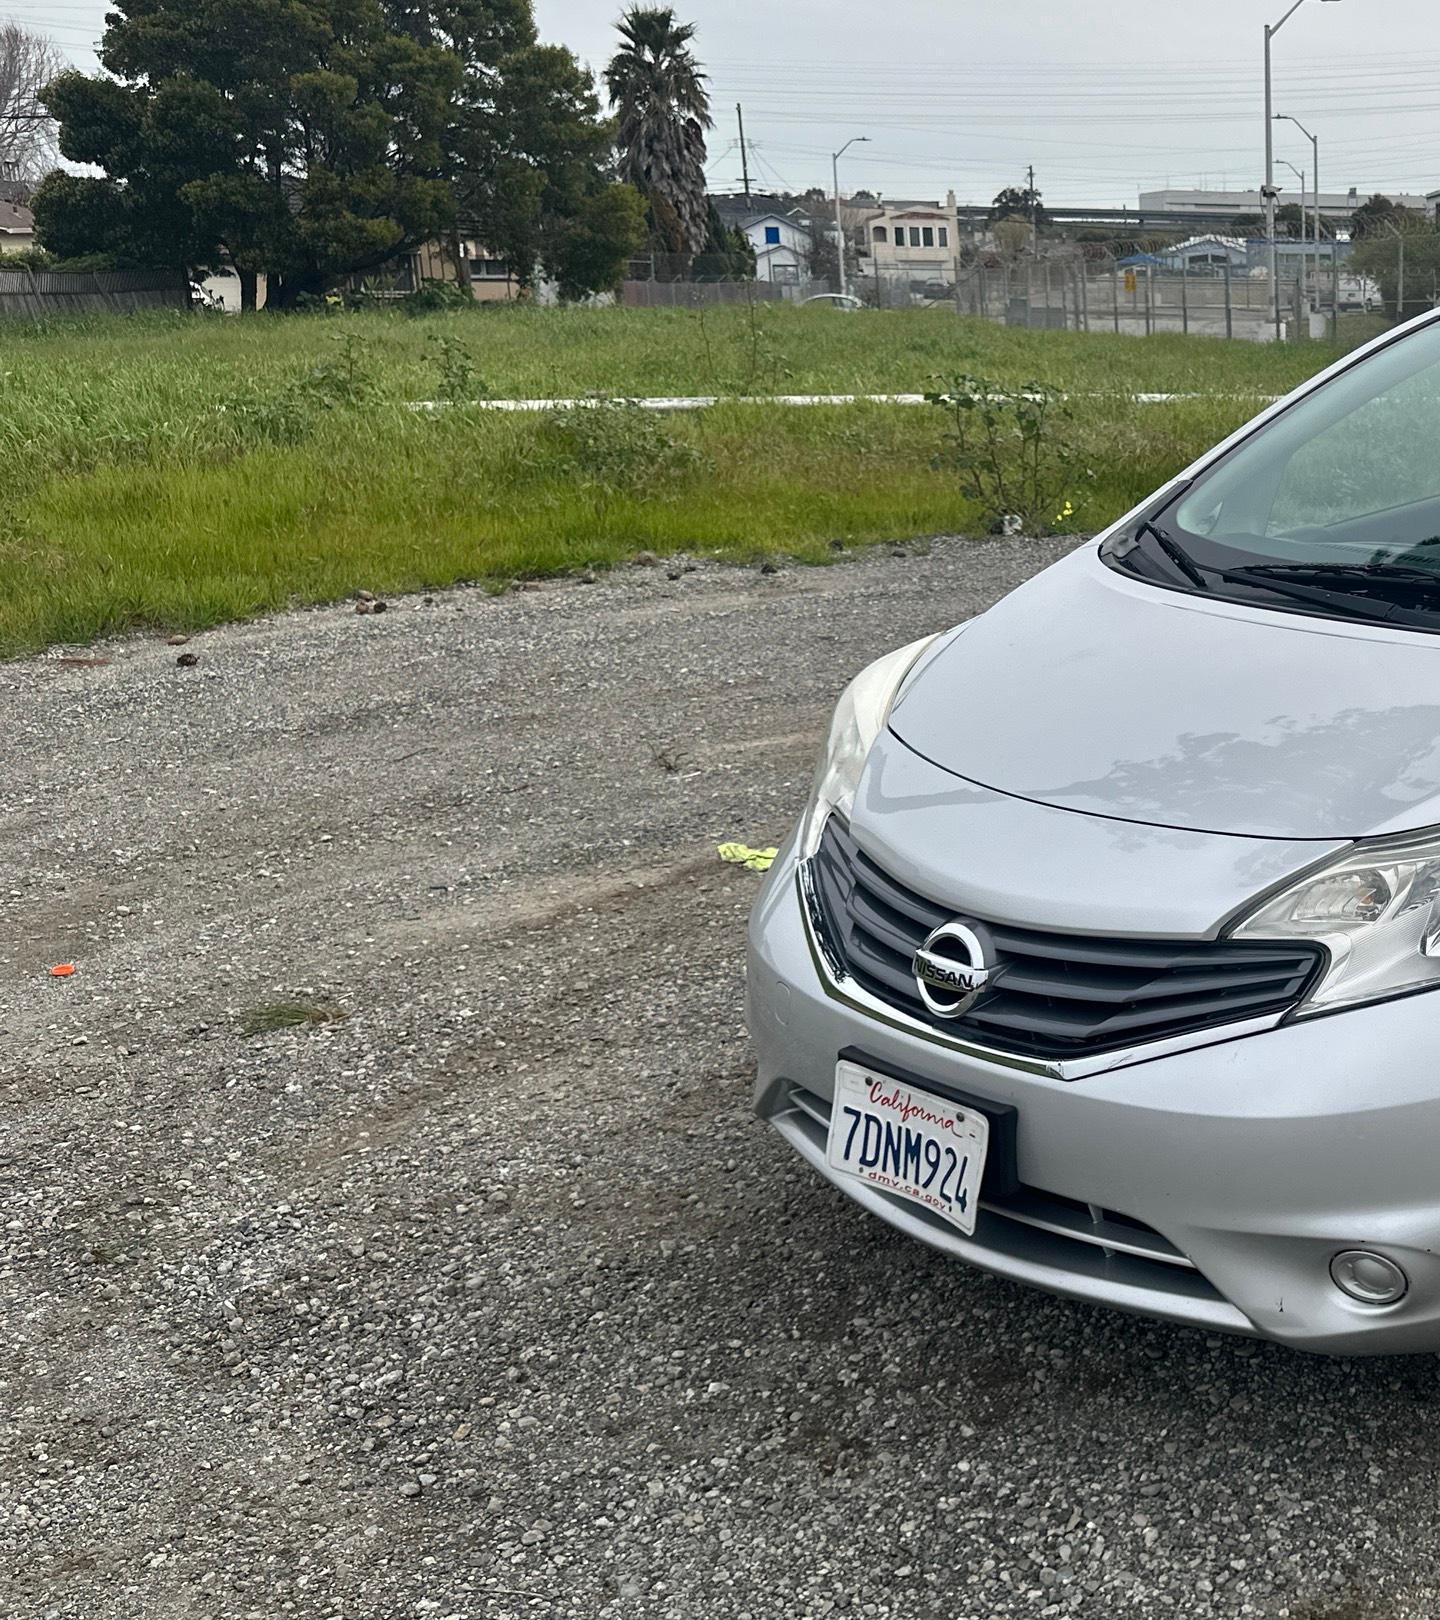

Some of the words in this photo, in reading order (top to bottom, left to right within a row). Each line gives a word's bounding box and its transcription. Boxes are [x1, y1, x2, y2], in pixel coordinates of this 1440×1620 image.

[915, 954, 973, 988] NISSAN
[869, 1080, 963, 1138] California
[843, 1105, 968, 1213] 7DNM924
[868, 1171, 946, 1210] dmv.ca.gov
